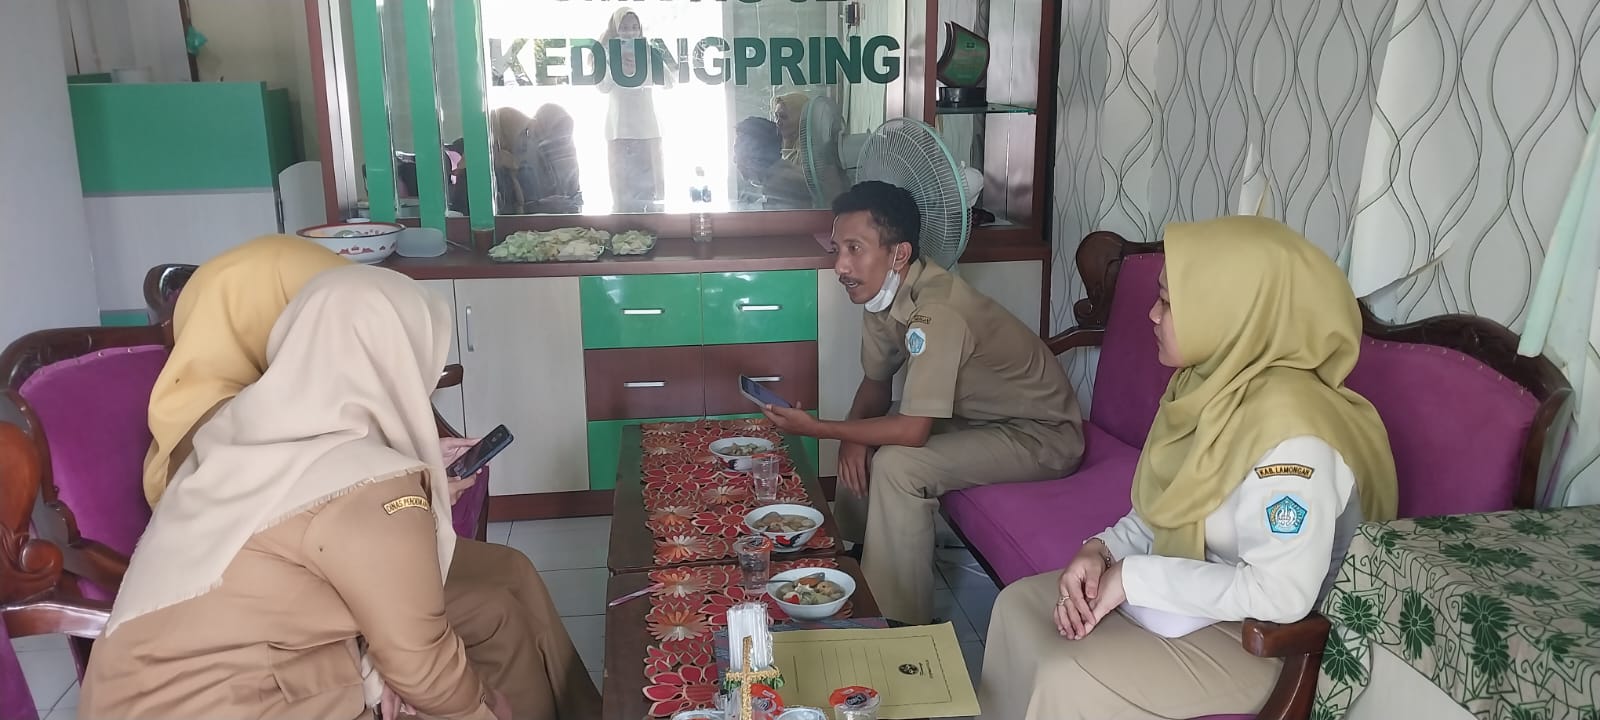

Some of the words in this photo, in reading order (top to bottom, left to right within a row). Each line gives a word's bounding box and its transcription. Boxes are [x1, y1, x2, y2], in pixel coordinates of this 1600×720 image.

[489, 35, 900, 87] KEDUNGPRING
[1276, 466, 1310, 476] LAMONGAN
[386, 499, 403, 513] DINAS
